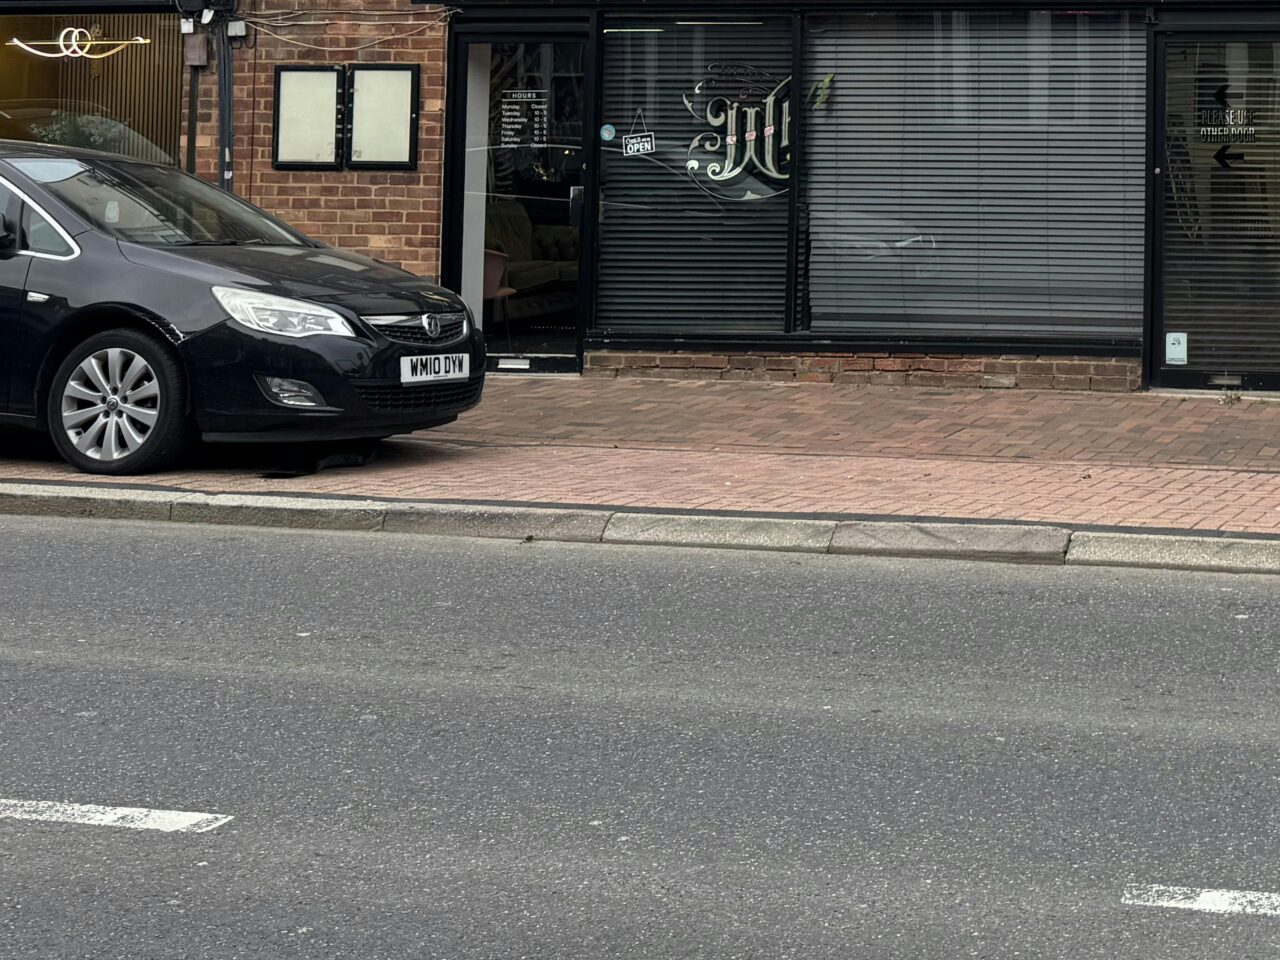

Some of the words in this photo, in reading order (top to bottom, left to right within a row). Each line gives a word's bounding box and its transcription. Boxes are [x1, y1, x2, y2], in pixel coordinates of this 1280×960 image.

[626, 141, 652, 153] OPEN
[410, 356, 441, 377] WM10
[444, 354, 464, 375] DYW
